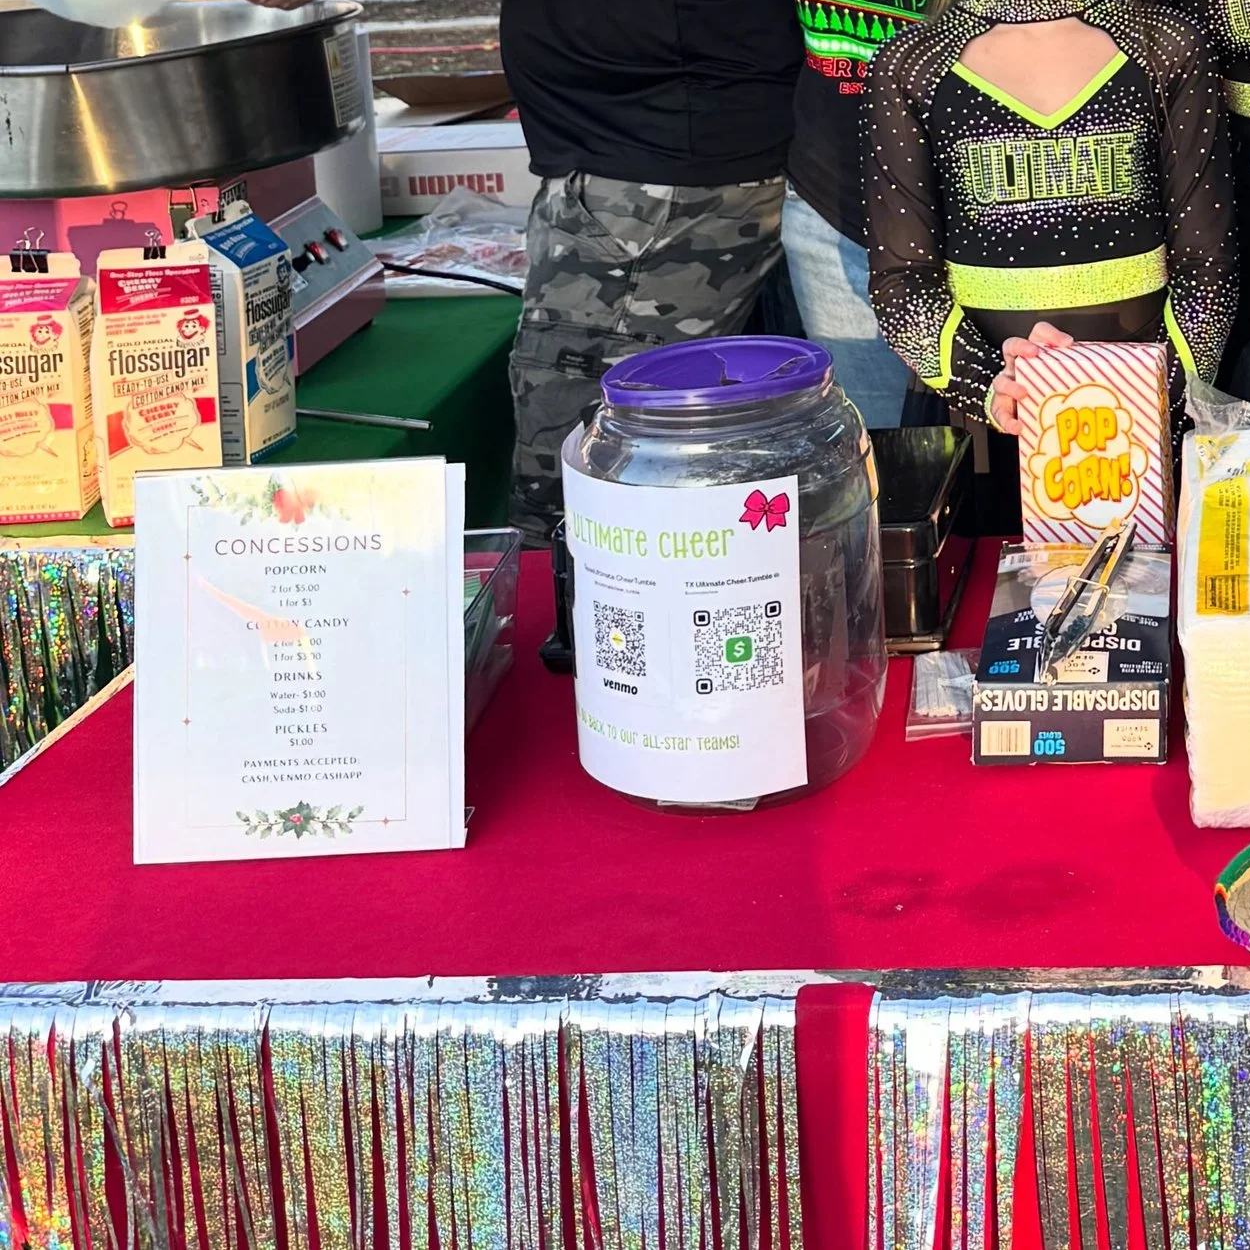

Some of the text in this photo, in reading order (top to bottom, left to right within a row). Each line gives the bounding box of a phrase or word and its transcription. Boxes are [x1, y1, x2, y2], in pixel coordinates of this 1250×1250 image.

[967, 132, 1134, 204] ULTIMATE
[0, 353, 63, 383] sugar
[108, 347, 210, 378] flossugar
[21, 387, 44, 400] CANDY
[47, 383, 60, 391] MIX
[116, 374, 169, 395] READY-TO-USE
[135, 377, 205, 407] COTTON CANDY MIX
[138, 402, 179, 417] CHERRY
[1056, 406, 1118, 457] POP
[1044, 453, 1134, 510] CORN!
[214, 534, 382, 556] CONCESSIONS
[264, 564, 327, 576] POPCORN
[271, 583, 320, 593] 2 for $5.00
[286, 599, 299, 607] for
[302, 598, 312, 607] $3
[304, 618, 350, 629] CANDY
[281, 653, 294, 661] for
[274, 671, 323, 682] DRINKS
[988, 664, 1021, 675] 500
[603, 677, 639, 696] venmo
[980, 689, 1161, 712] DISPOSABLE GLOVES
[275, 723, 328, 735] PICKLES
[607, 724, 617, 740] TO
[1038, 731, 1063, 739] GLOVES
[289, 738, 314, 747] $1.00
[1033, 740, 1066, 756] 500
[244, 758, 299, 768] PAYMENTS
